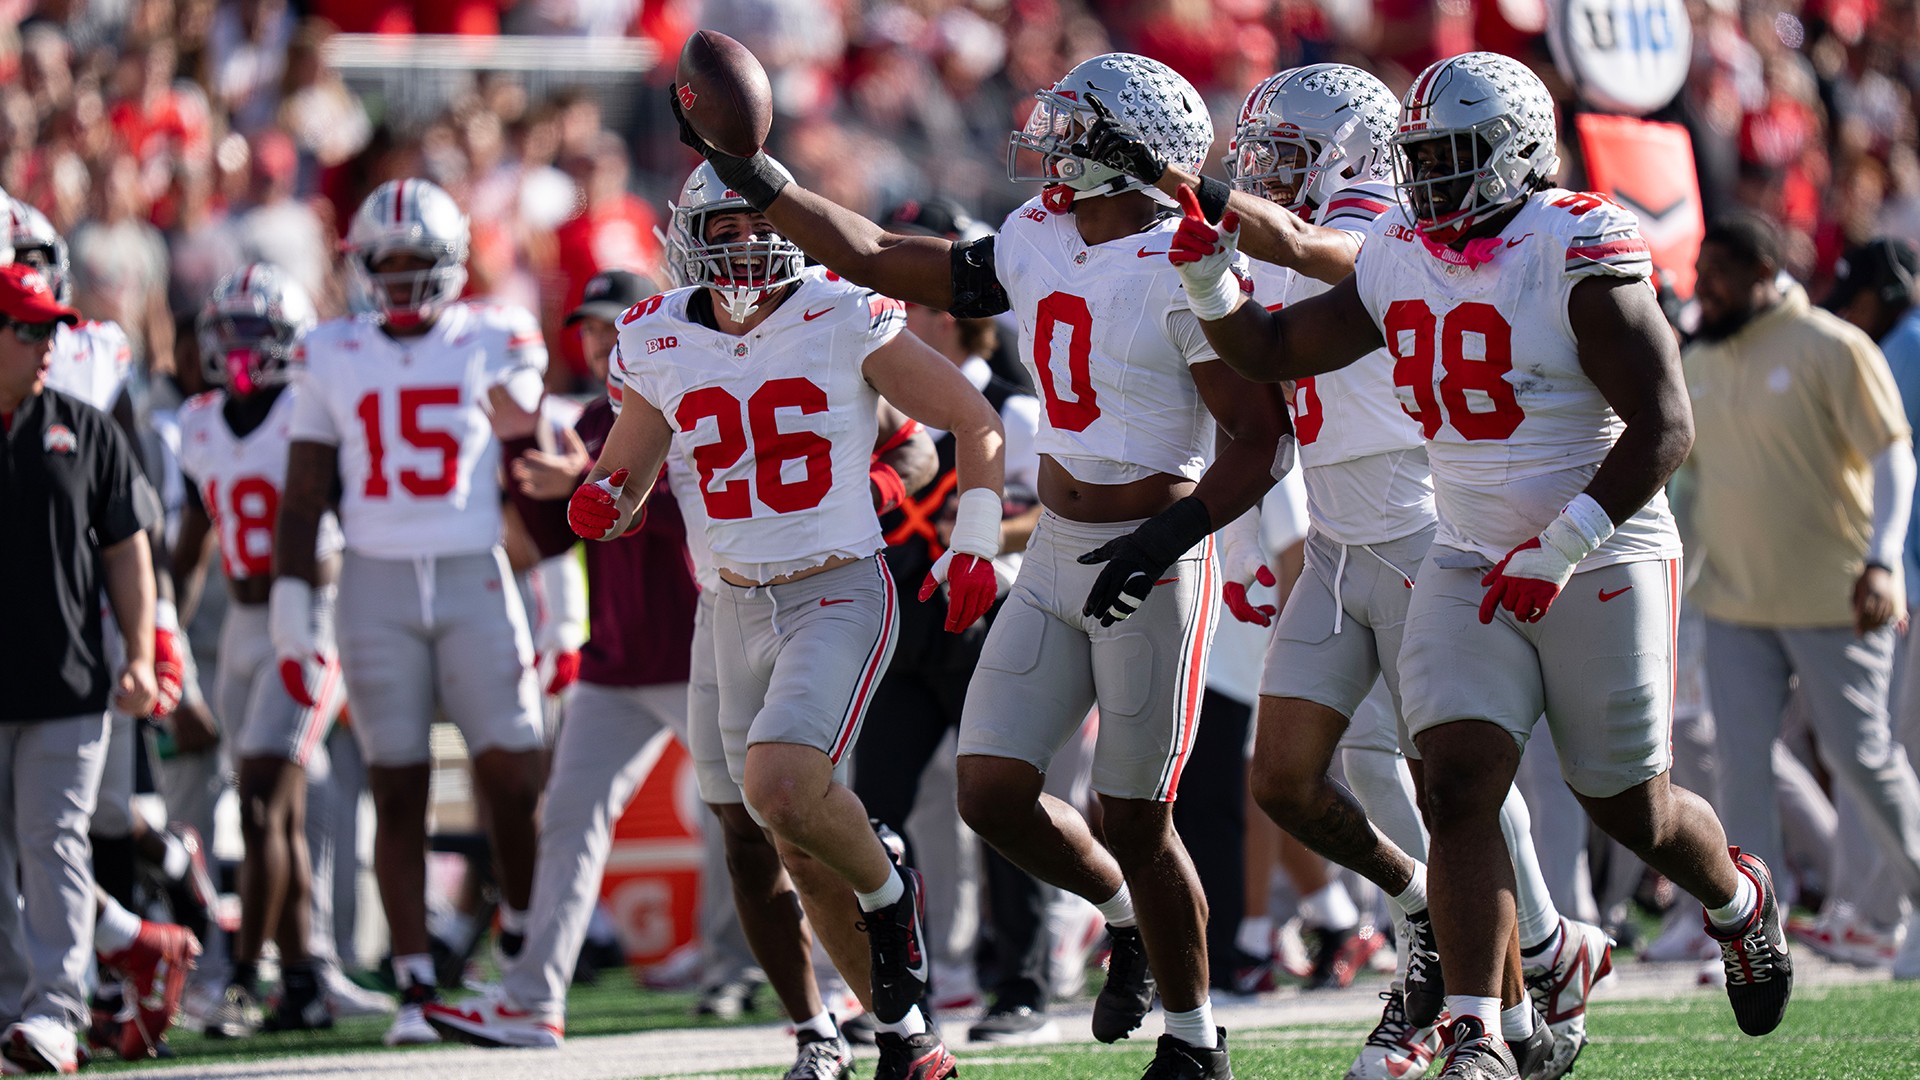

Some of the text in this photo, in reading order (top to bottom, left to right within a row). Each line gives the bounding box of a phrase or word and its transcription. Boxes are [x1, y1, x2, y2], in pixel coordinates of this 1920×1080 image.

[1033, 290, 1101, 433] 0
[1382, 298, 1526, 441] 98
[357, 385, 459, 498] 15
[674, 376, 833, 520] 26
[204, 474, 282, 577] 18
